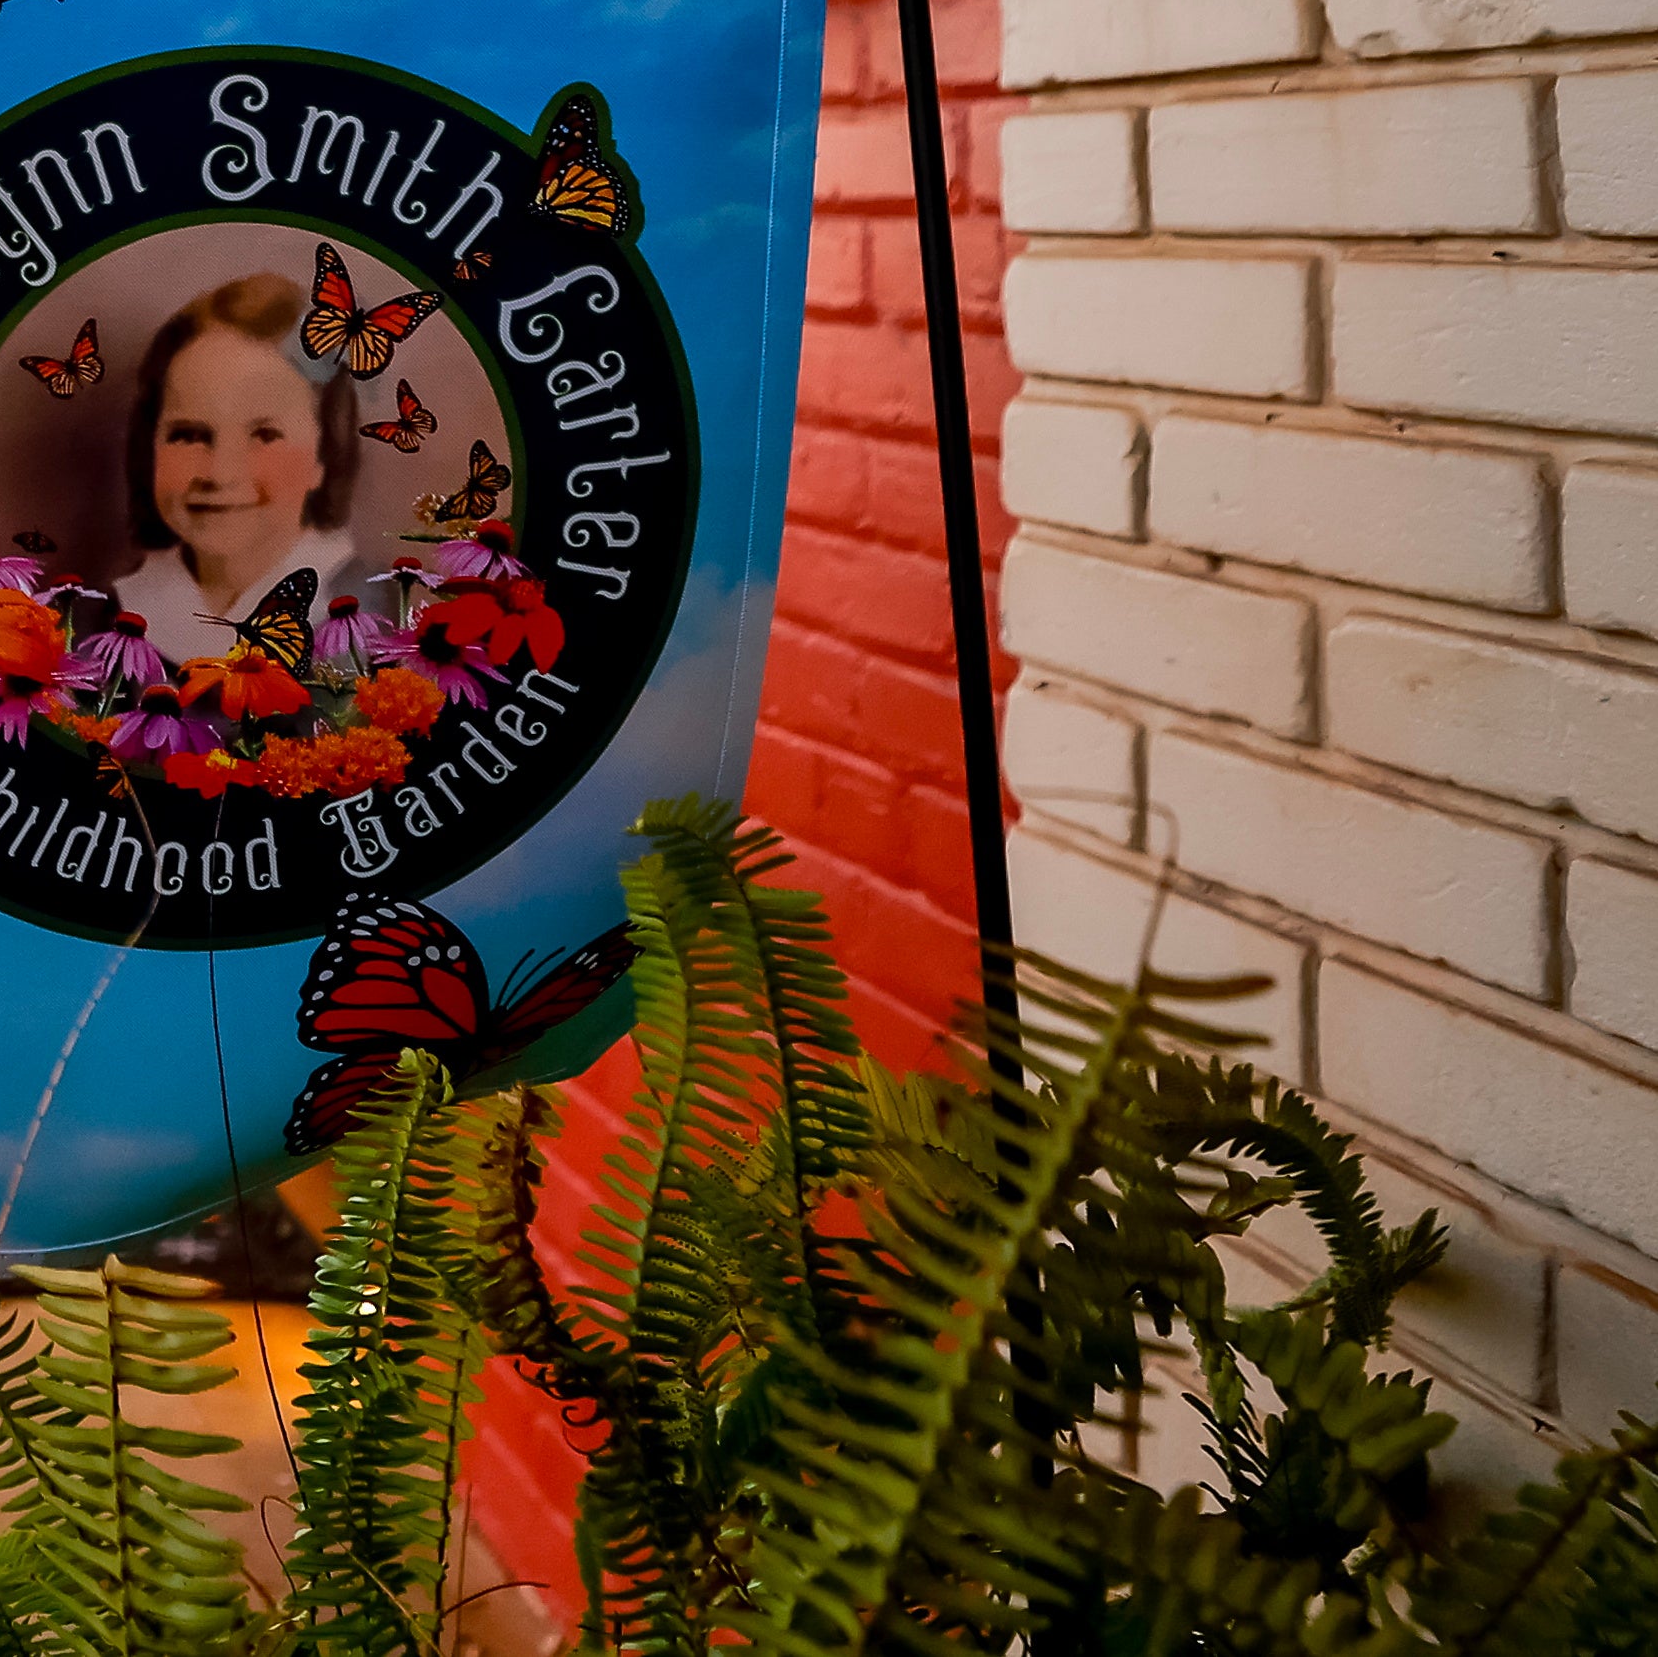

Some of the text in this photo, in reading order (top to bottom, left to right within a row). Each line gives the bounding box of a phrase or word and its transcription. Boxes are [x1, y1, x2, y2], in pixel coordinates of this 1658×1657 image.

[201, 73, 504, 260] Smith
[498, 264, 672, 602] Carter
[319, 668, 581, 878] Garden
